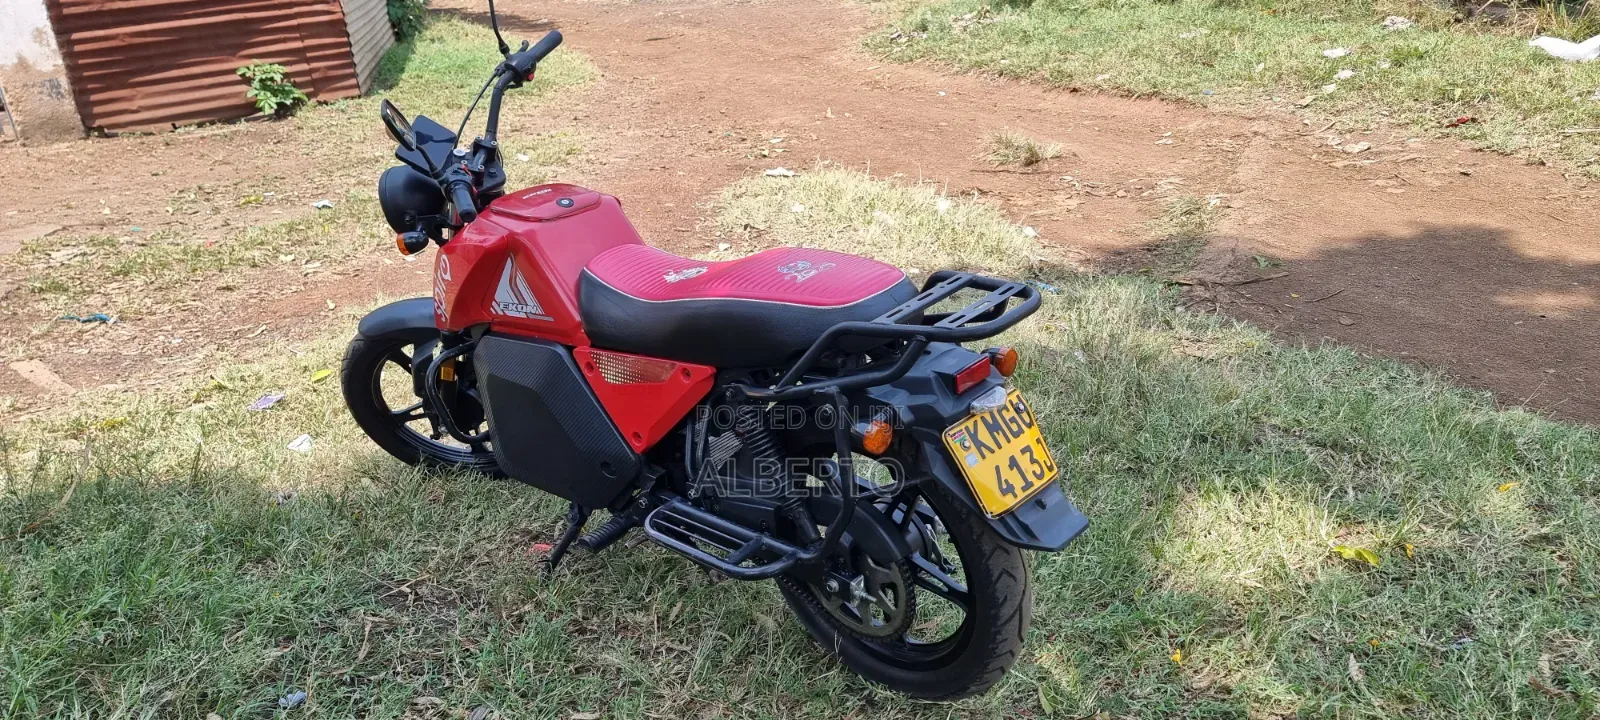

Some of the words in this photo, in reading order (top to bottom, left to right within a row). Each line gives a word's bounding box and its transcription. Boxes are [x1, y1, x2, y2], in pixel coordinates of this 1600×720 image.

[499, 302, 537, 315] EKON
[964, 394, 1034, 460] KMGU
[994, 437, 1054, 499] 413J
